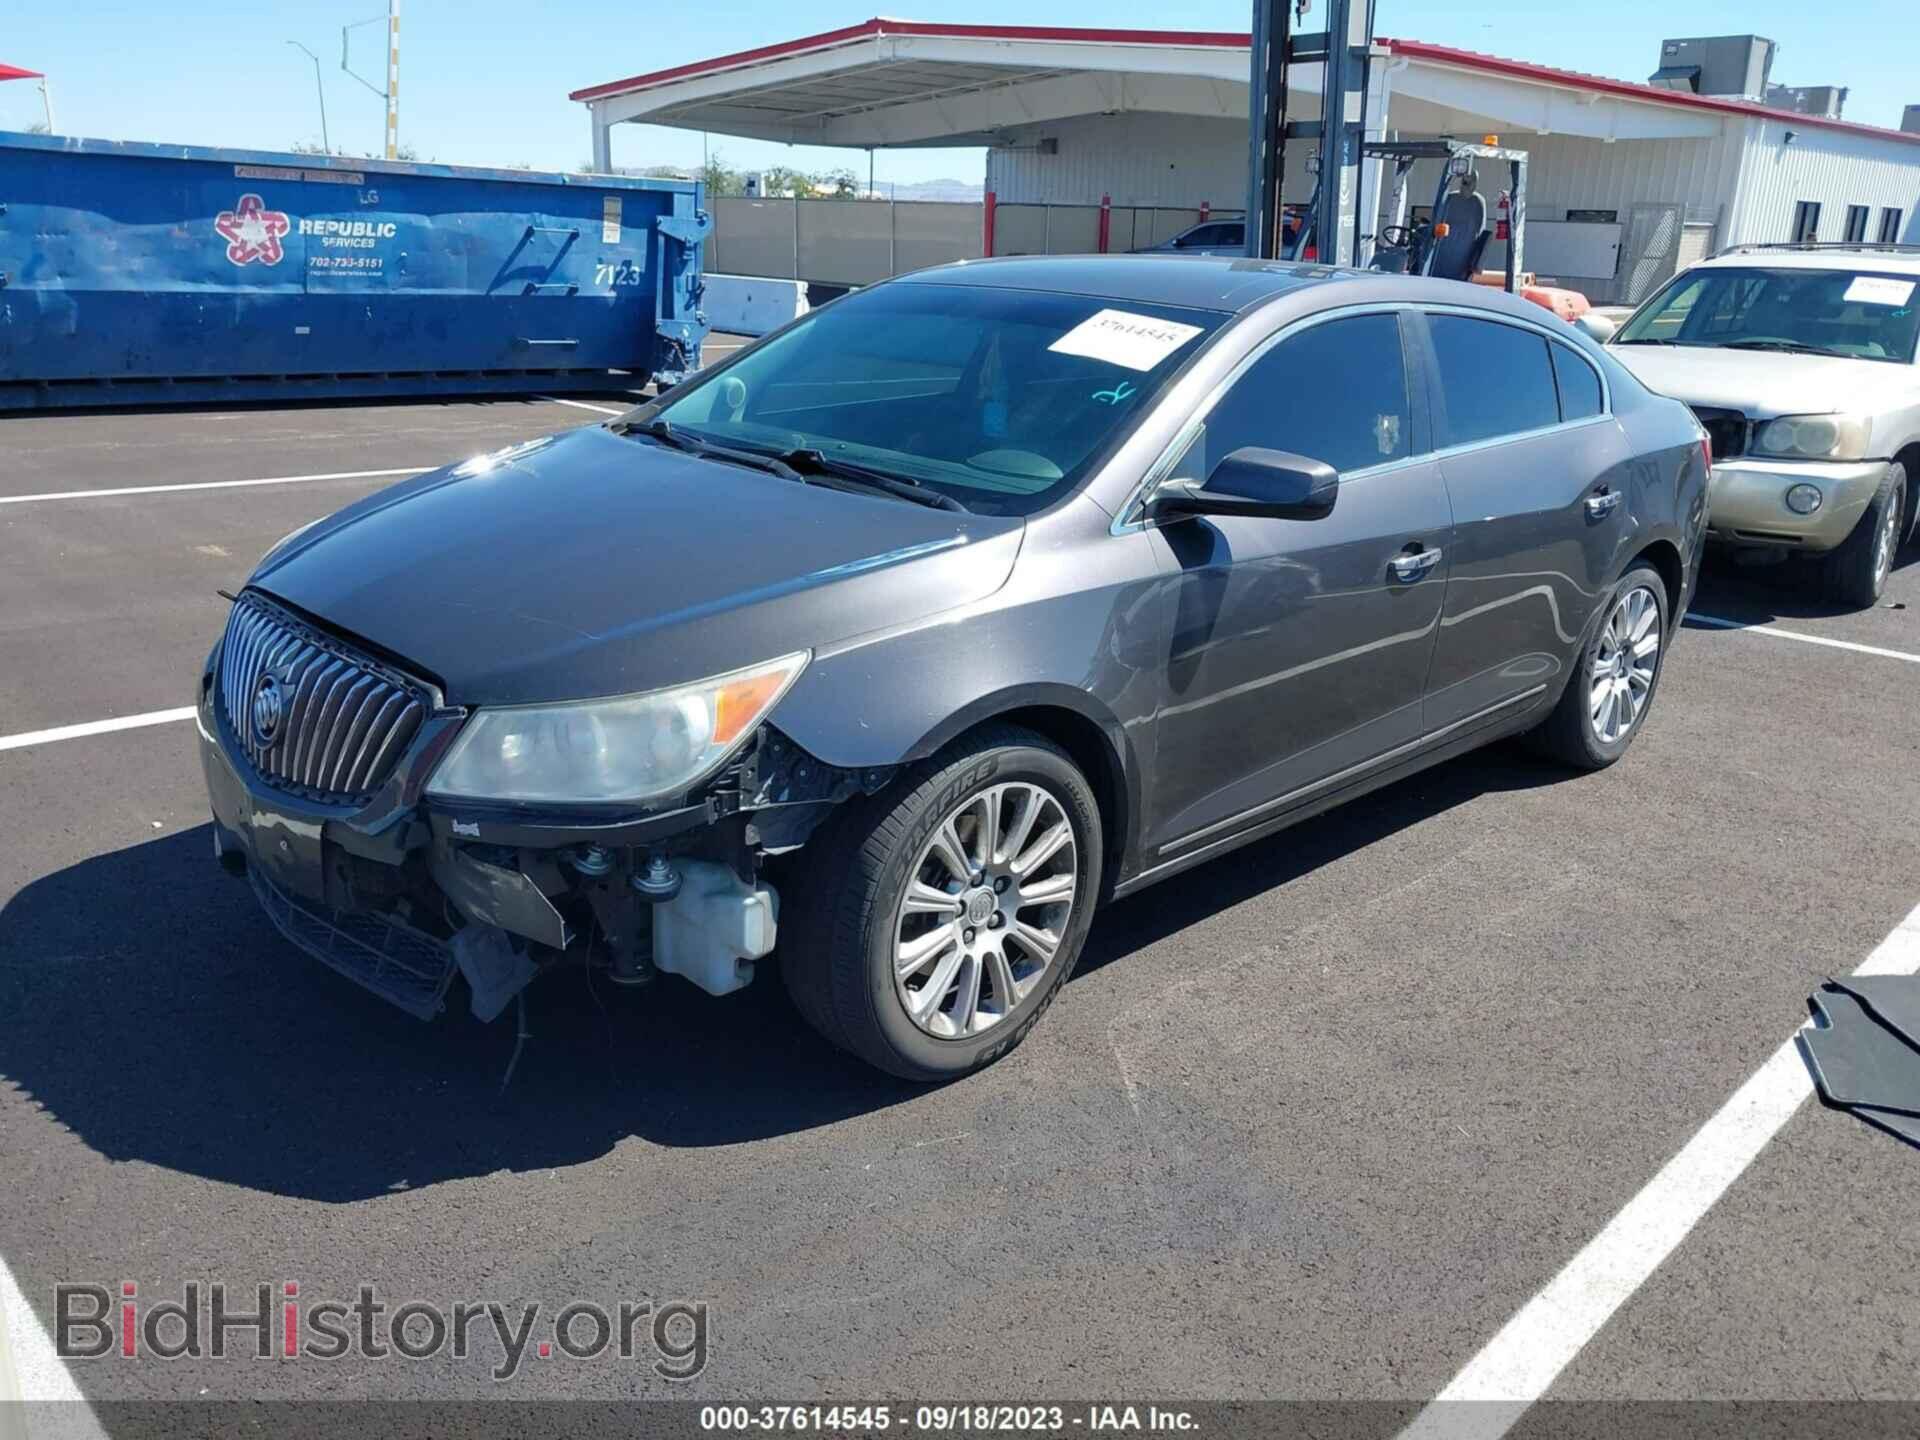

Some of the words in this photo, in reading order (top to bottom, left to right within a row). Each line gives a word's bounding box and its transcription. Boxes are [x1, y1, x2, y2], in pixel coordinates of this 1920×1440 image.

[298, 219, 396, 237] REPUBLIC
[322, 237, 375, 248] SERVICES
[595, 264, 640, 286] 7123
